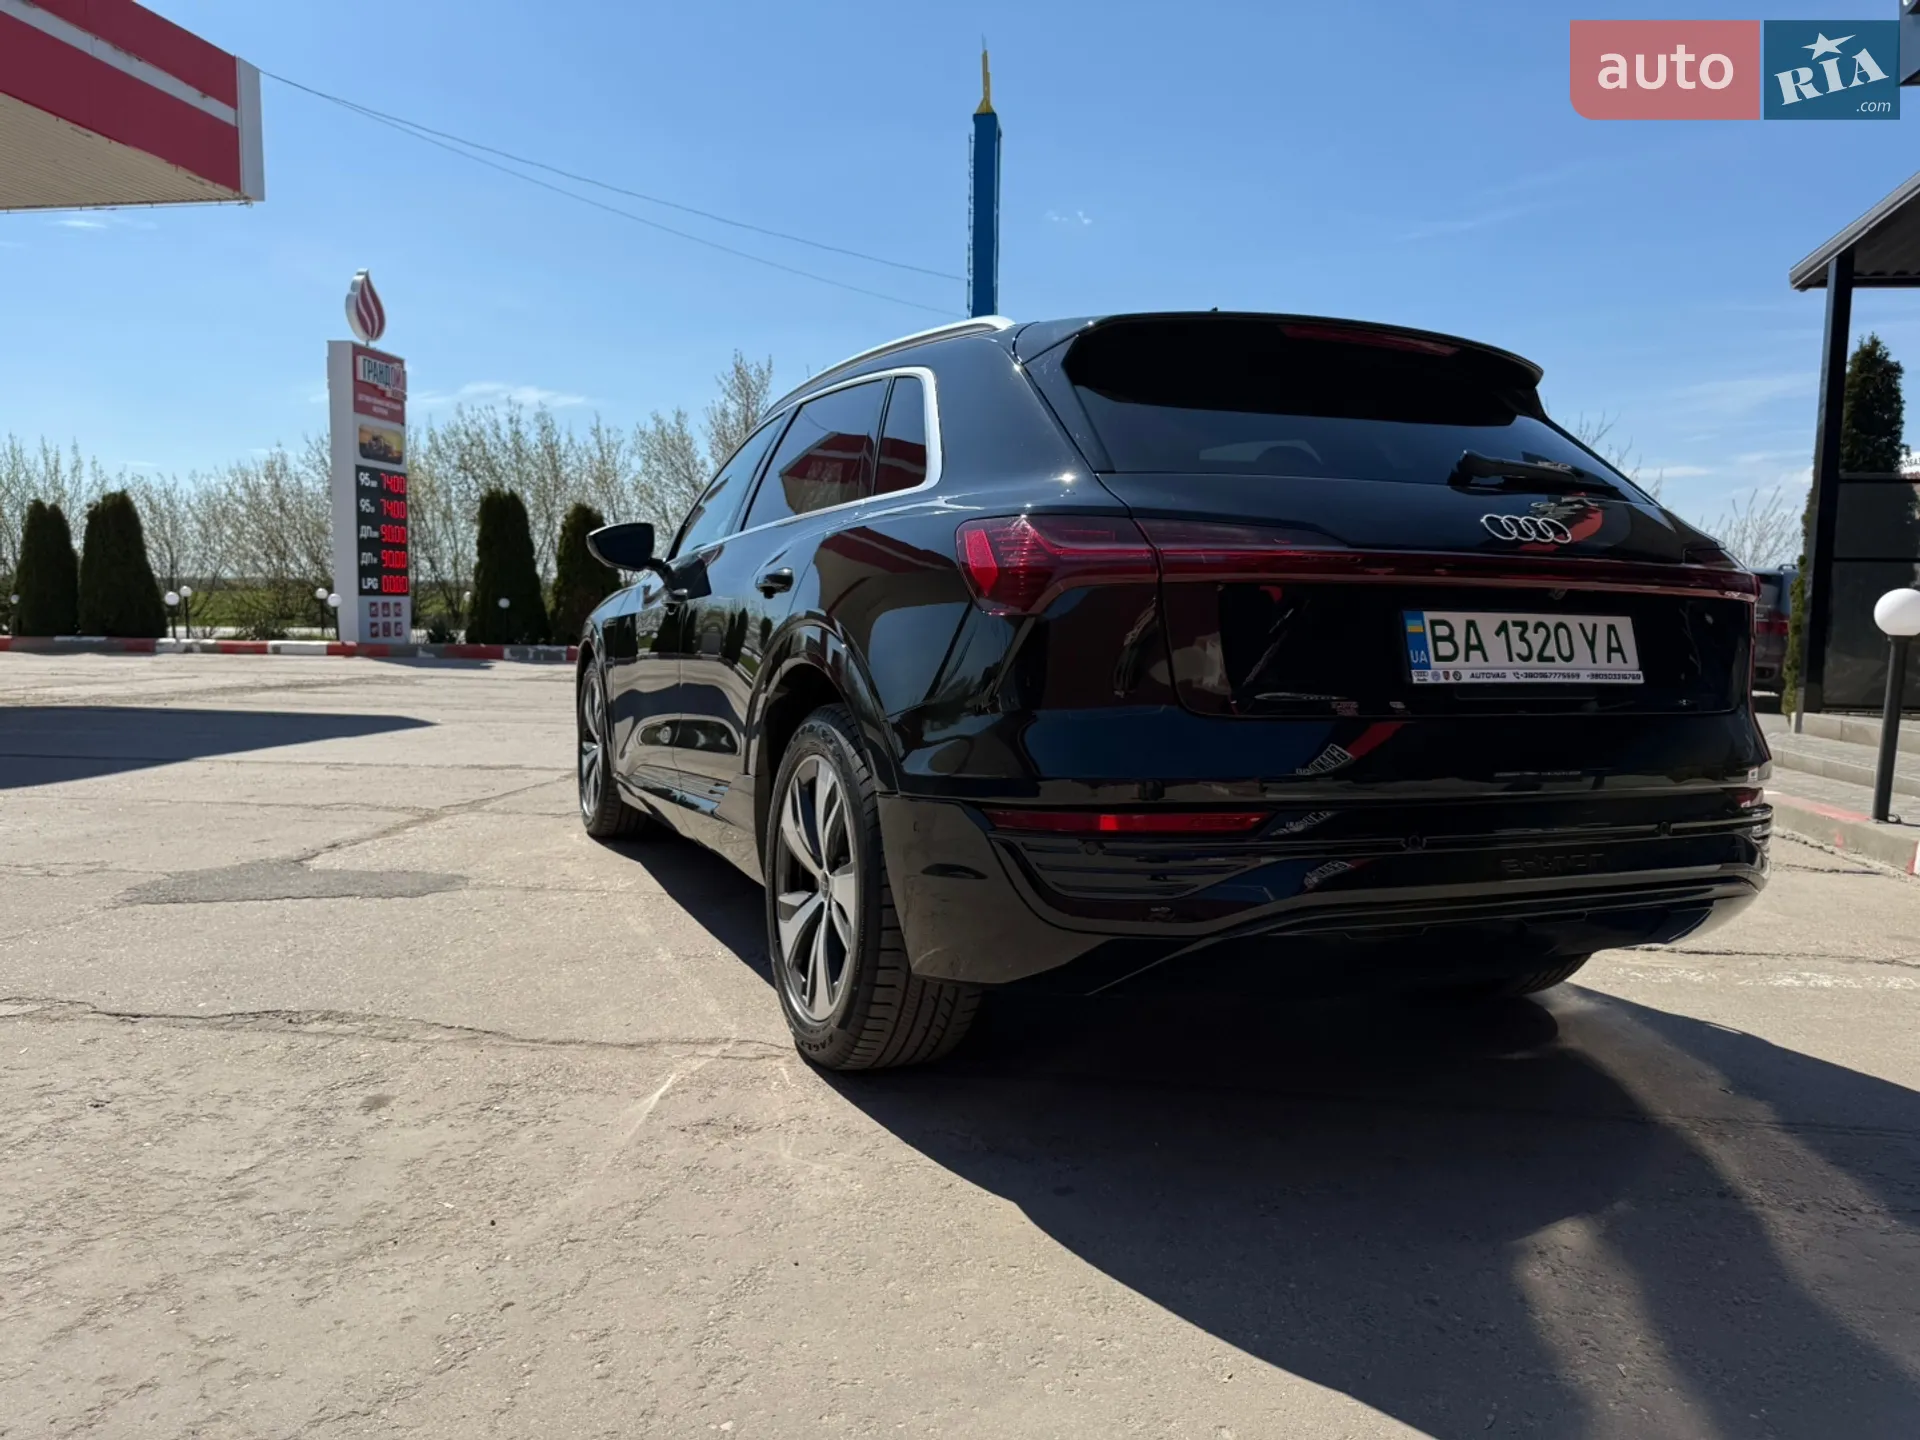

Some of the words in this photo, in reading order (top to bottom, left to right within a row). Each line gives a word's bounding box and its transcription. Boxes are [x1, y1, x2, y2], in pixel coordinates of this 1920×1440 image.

[362, 577, 379, 590] LPG
[1429, 619, 1489, 663] BA
[1494, 620, 1575, 663] 1320
[1578, 622, 1628, 664] YA
[1411, 650, 1429, 664] UA
